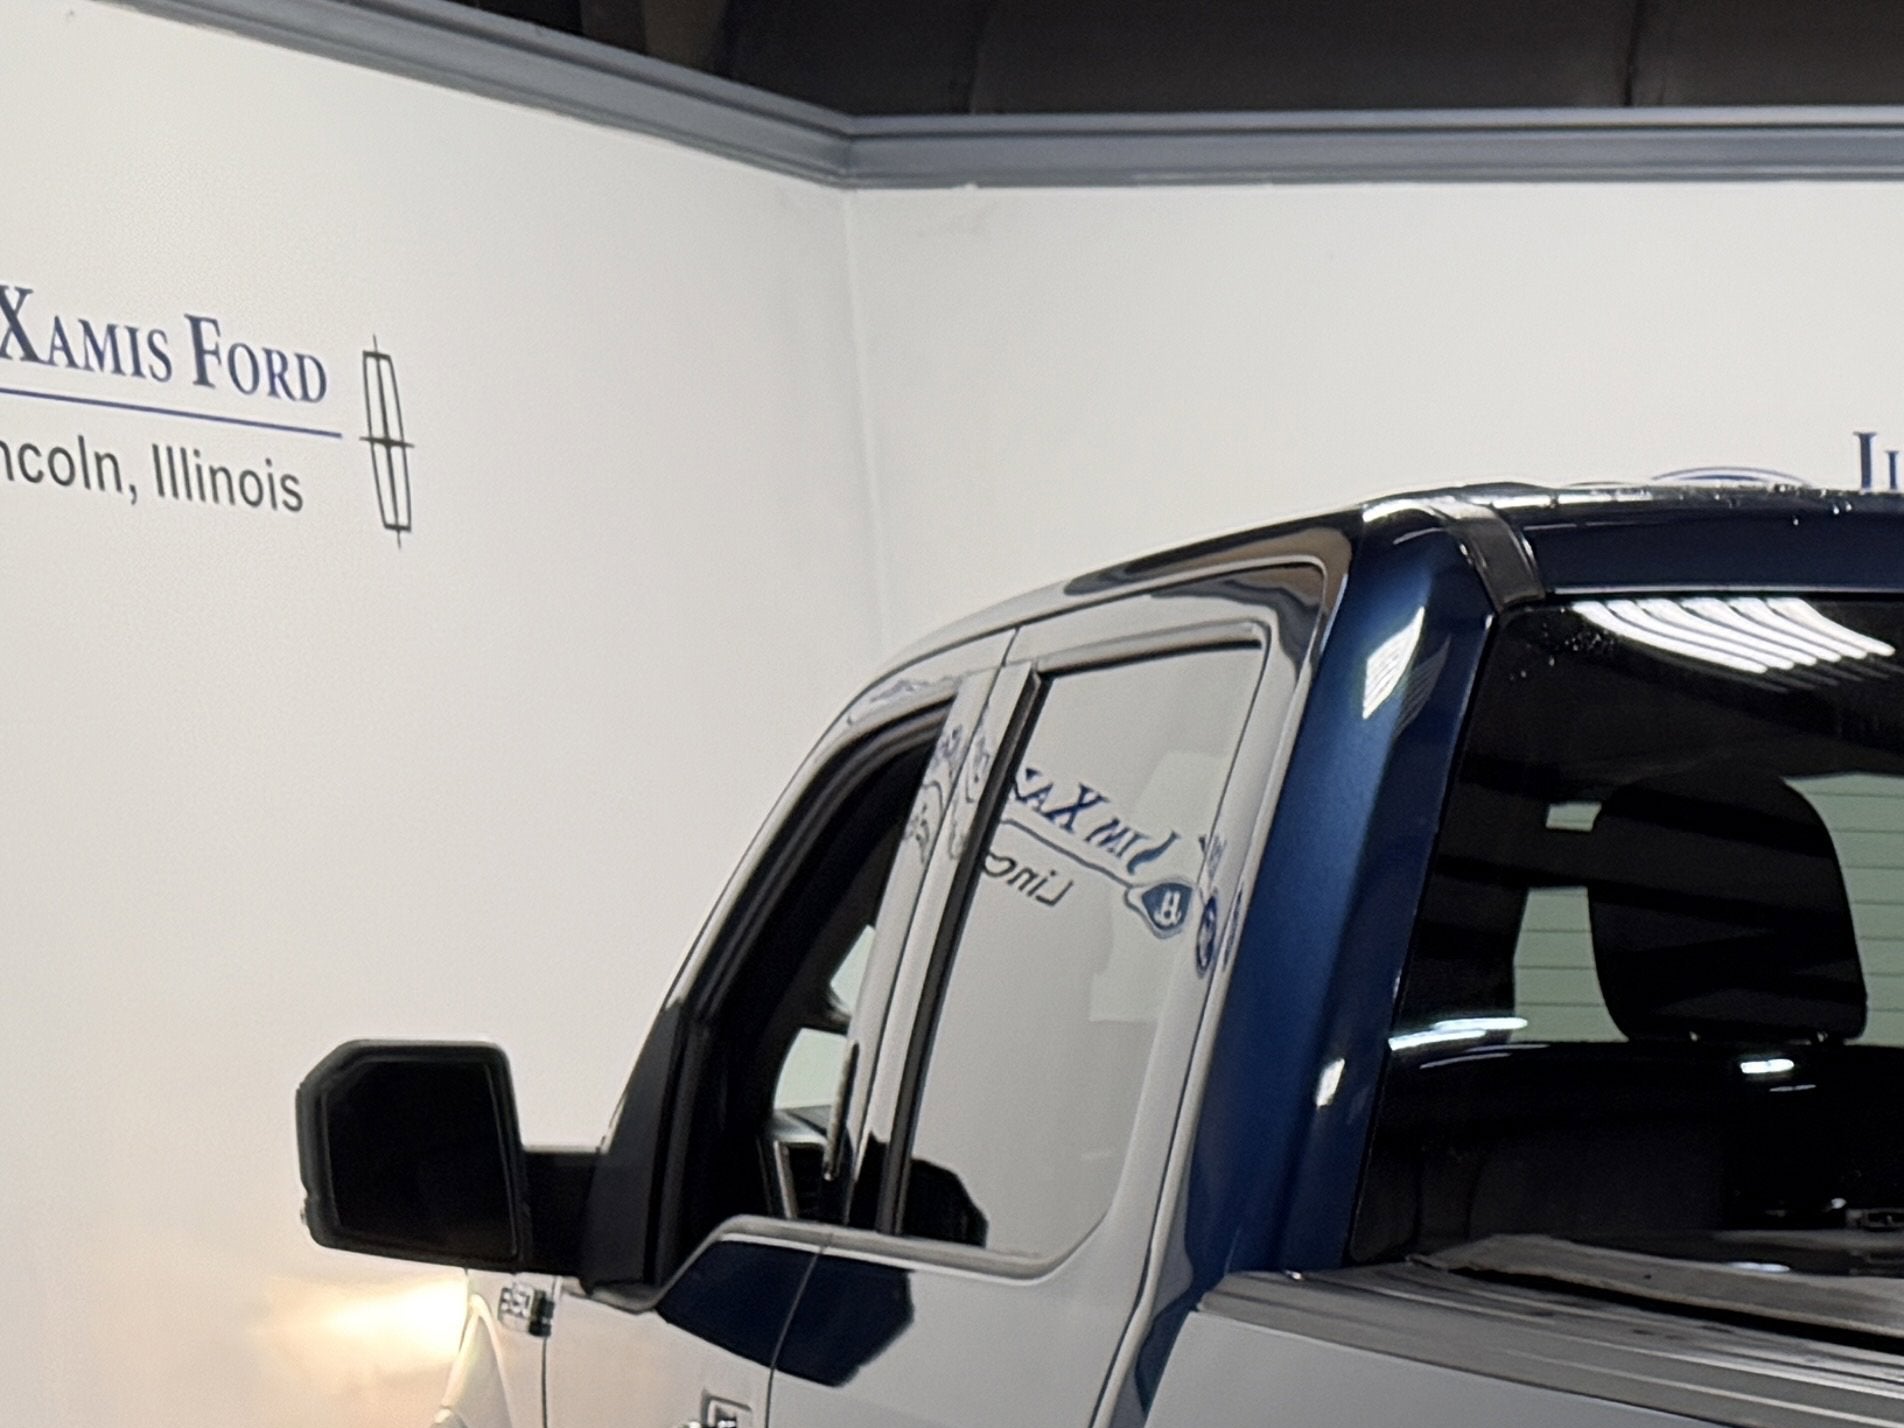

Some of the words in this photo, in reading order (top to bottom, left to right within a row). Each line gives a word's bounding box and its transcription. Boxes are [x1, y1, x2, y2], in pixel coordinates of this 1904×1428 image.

[0, 284, 173, 383] XAMIS
[184, 313, 328, 404] FORD
[152, 443, 303, 514] Illinois
